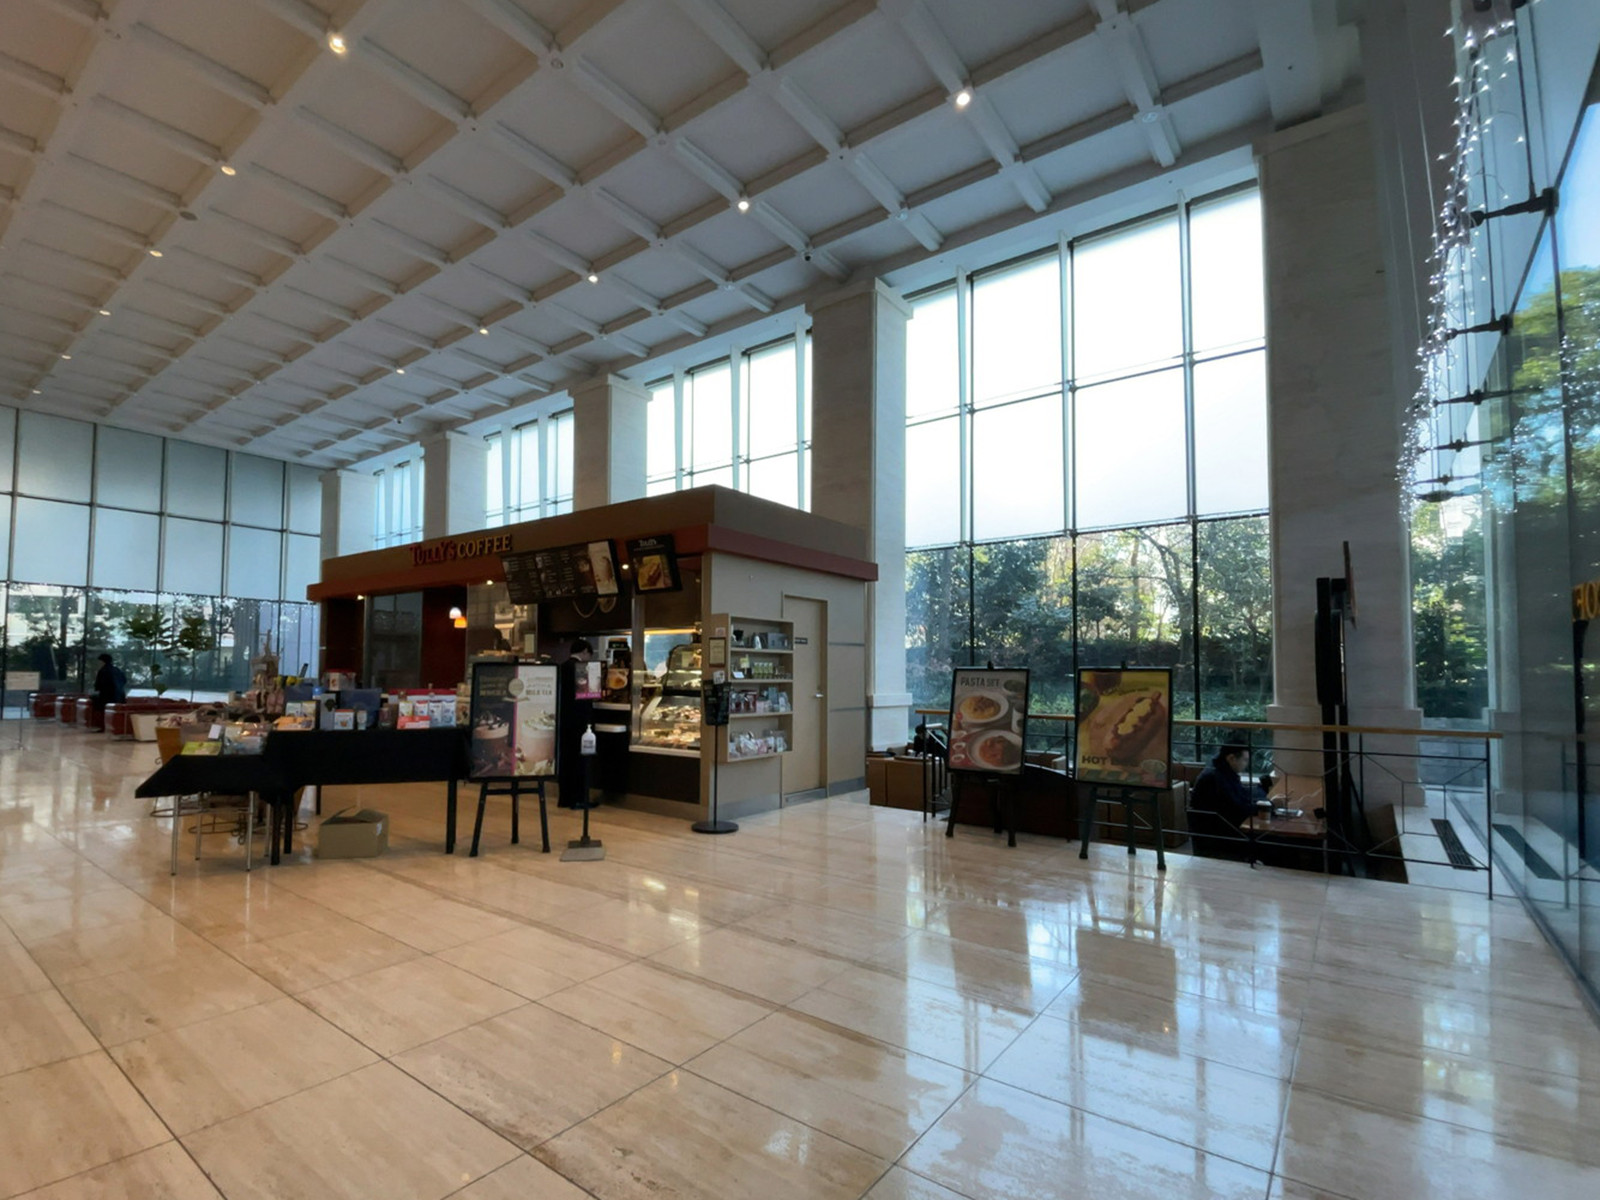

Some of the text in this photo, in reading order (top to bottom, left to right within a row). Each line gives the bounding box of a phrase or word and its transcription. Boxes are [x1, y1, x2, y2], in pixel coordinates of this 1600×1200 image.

[457, 533, 512, 557] COFFEE
[960, 677, 985, 687] PASTA
[1081, 755, 1108, 765] HOT
